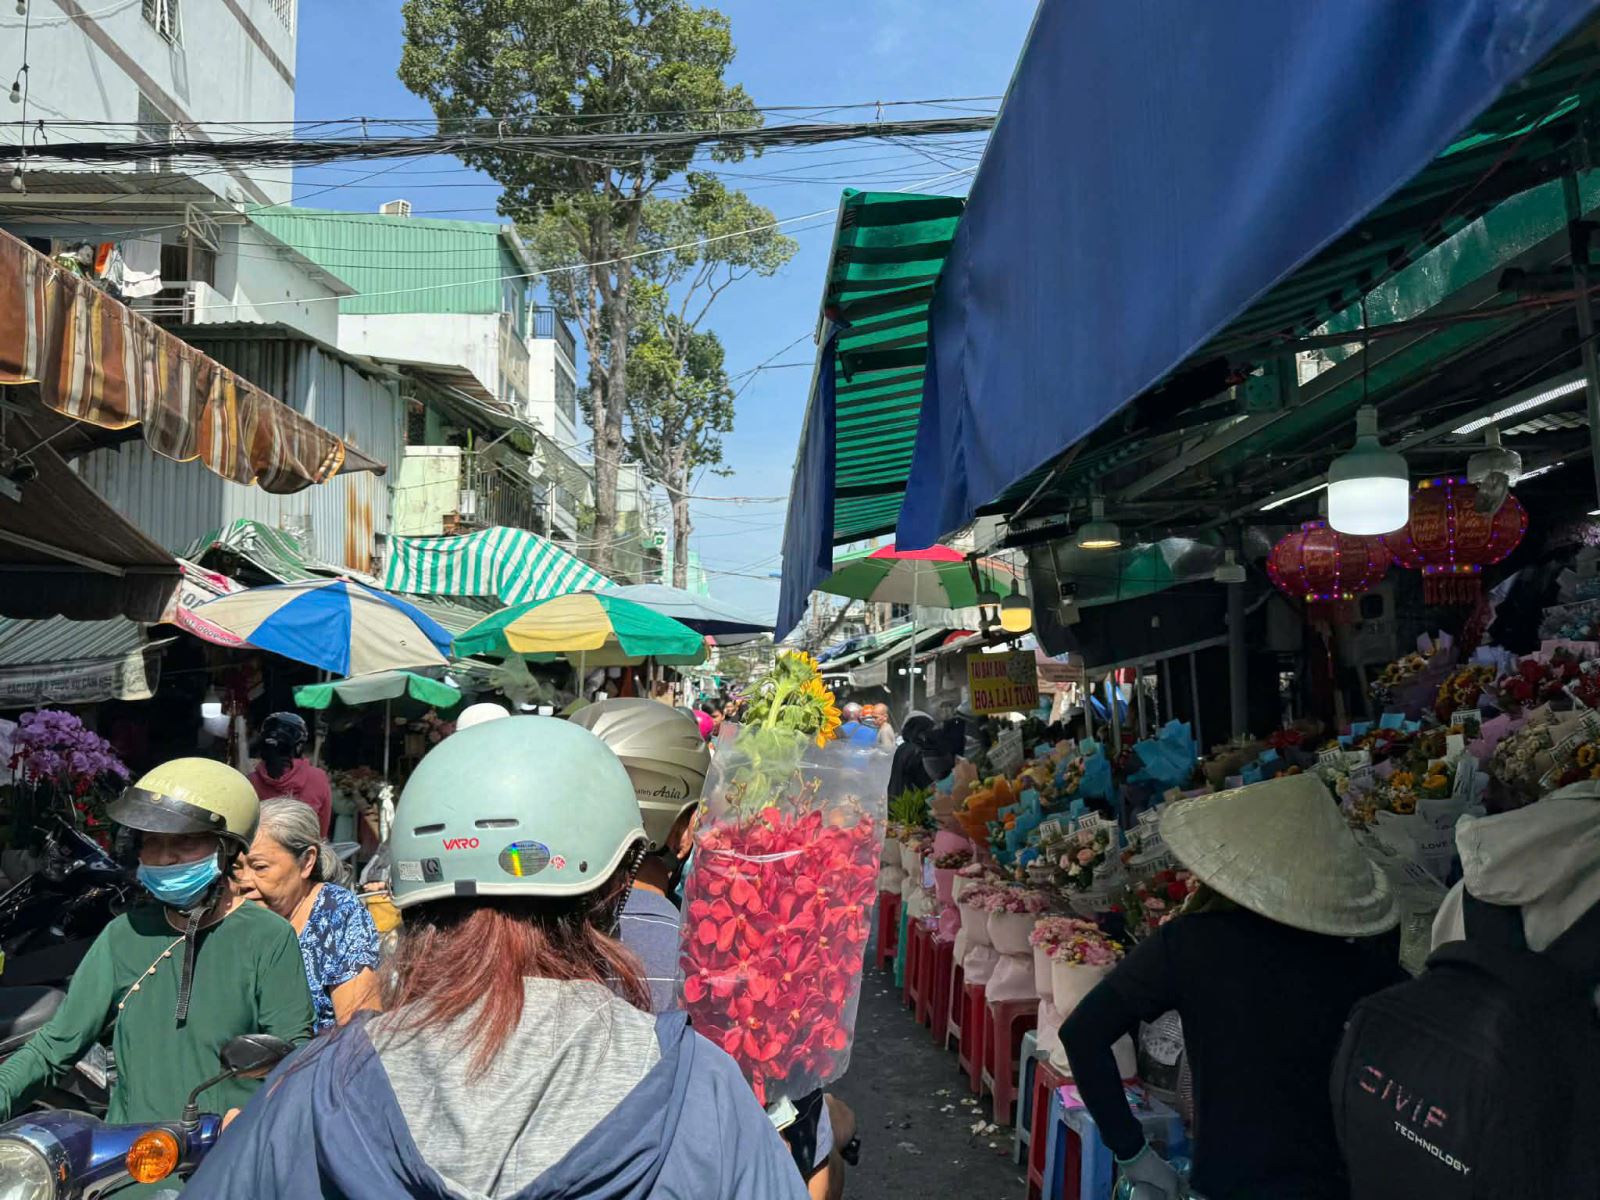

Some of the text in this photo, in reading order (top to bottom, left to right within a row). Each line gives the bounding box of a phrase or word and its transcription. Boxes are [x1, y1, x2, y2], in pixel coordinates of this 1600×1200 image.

[653, 785, 681, 799] Asia
[443, 837, 480, 850] VARO
[1394, 1121, 1471, 1175] TECHNOLOGY
